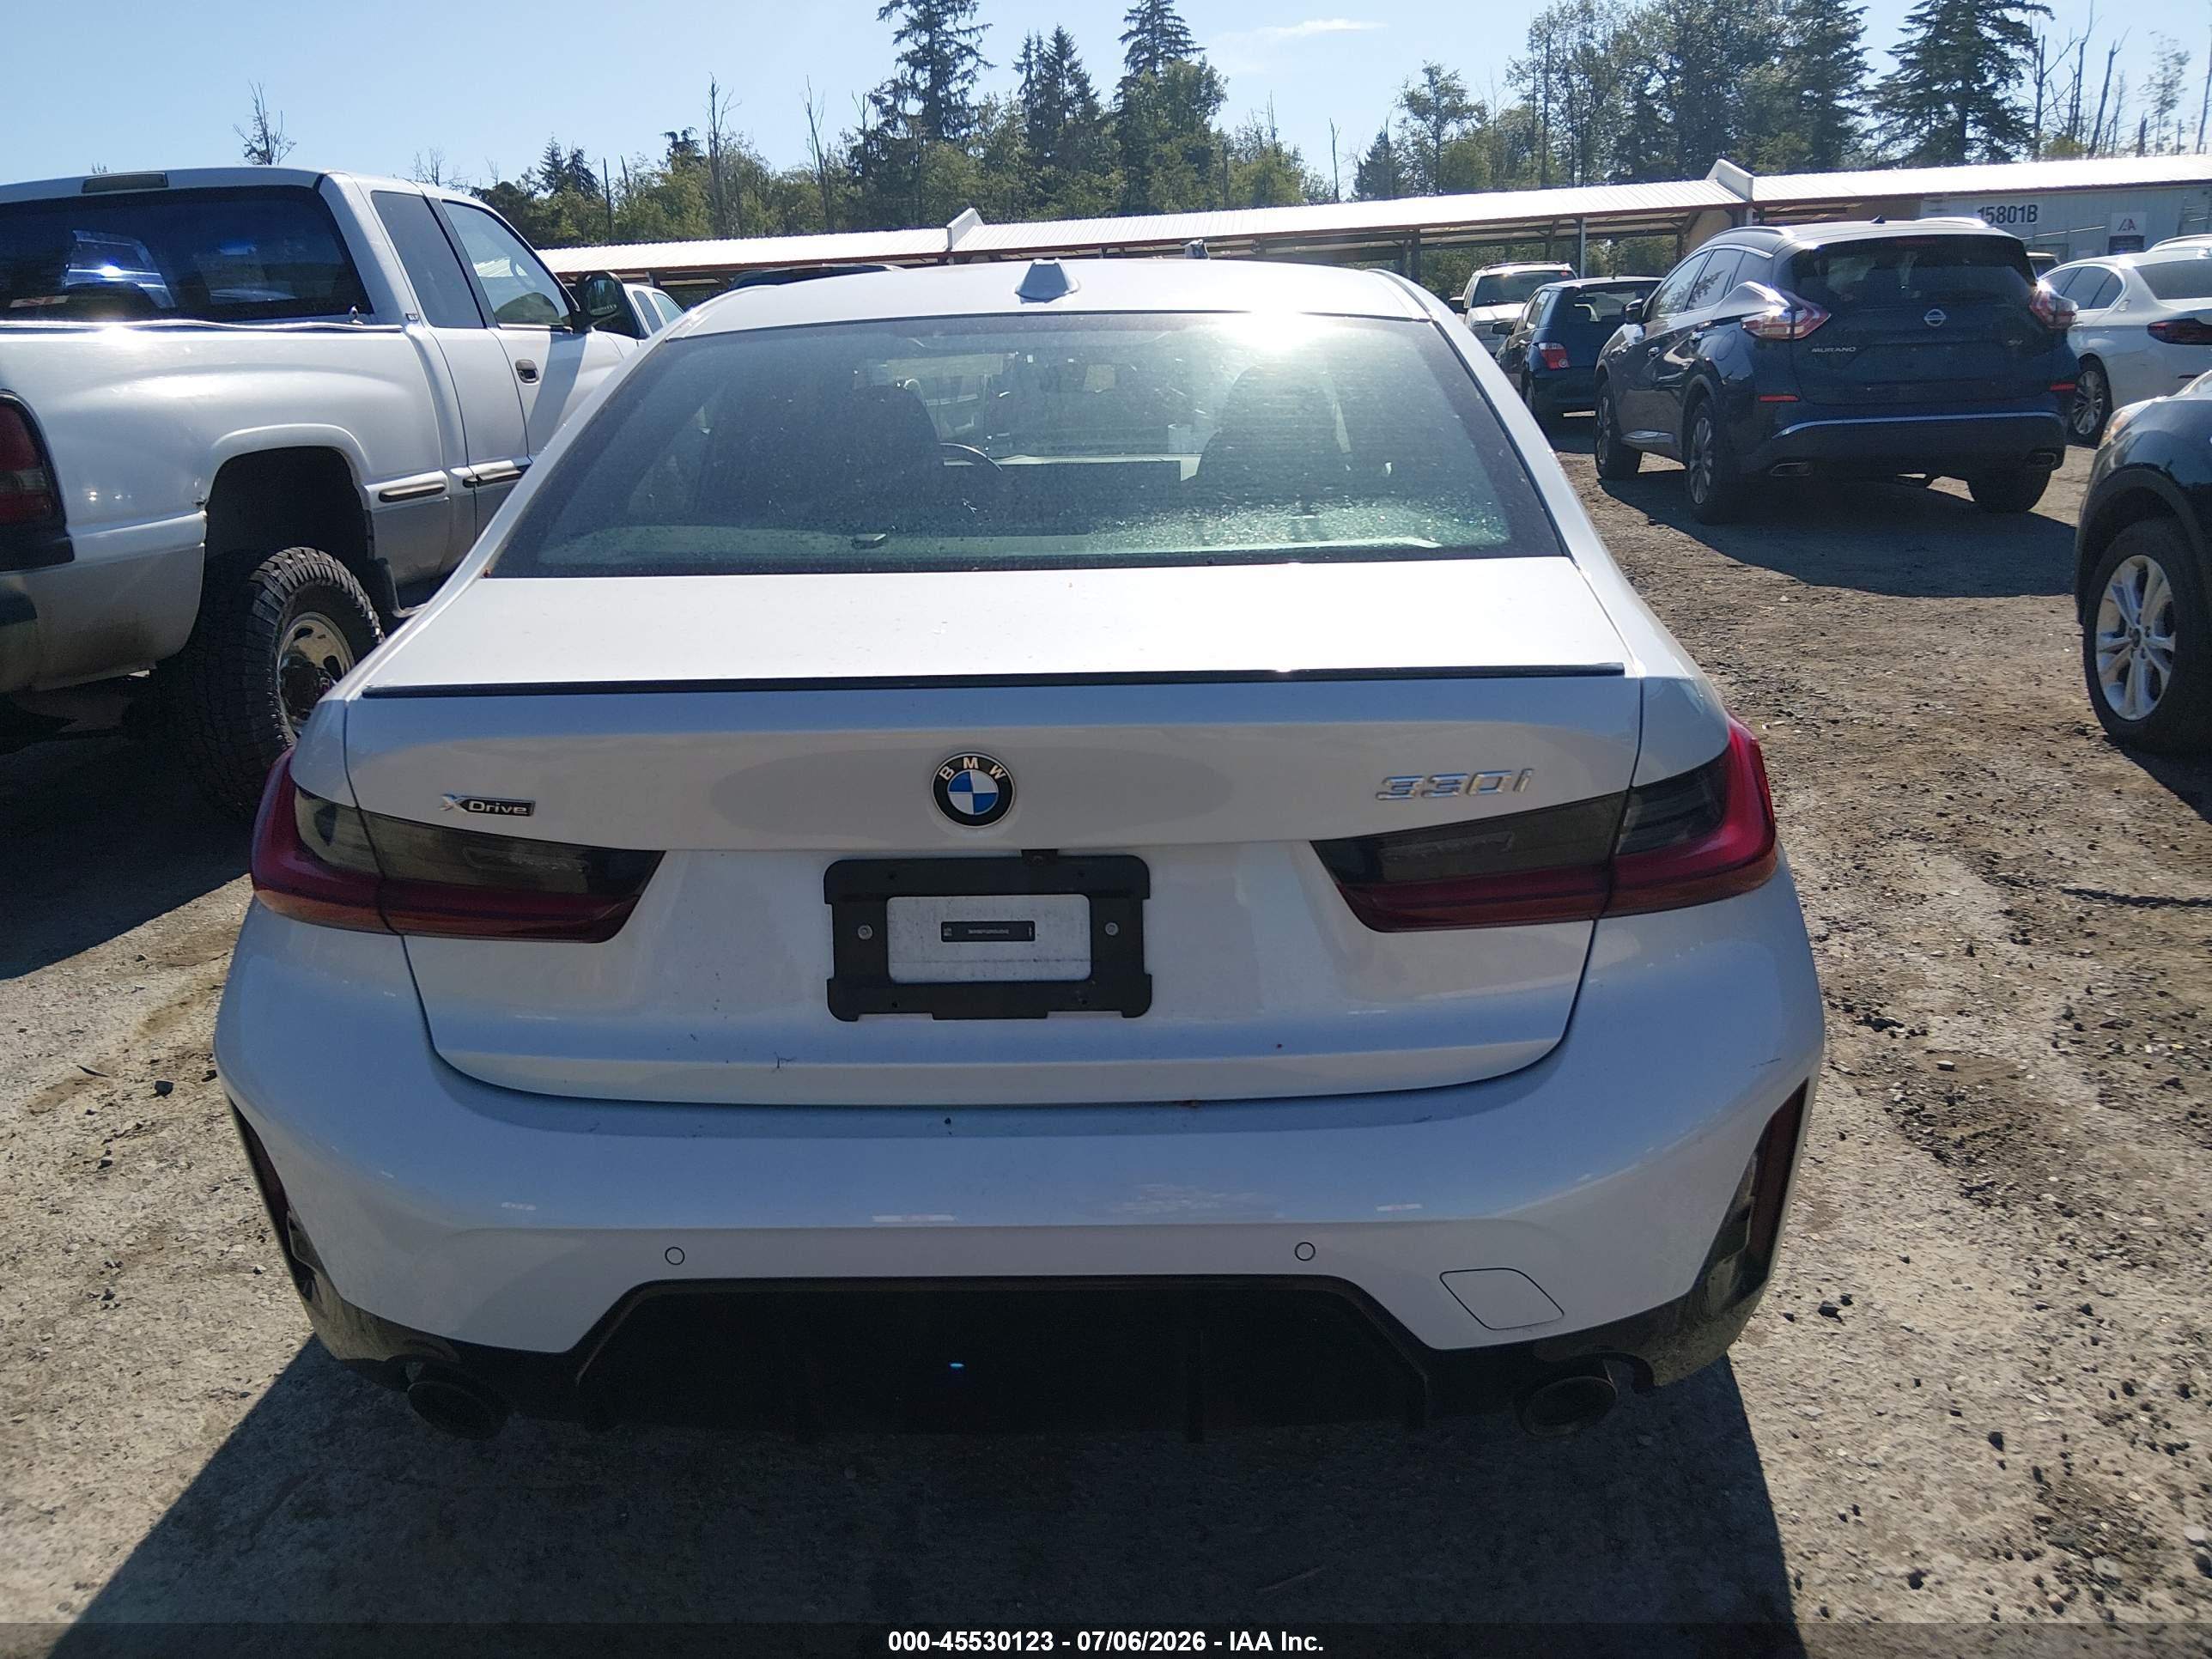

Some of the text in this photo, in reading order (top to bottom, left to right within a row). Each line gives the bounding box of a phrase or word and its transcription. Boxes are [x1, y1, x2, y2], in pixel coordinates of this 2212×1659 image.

[1978, 204, 2039, 224] 15801B
[939, 757, 1006, 781] BMW
[1376, 768, 1534, 800] 330i
